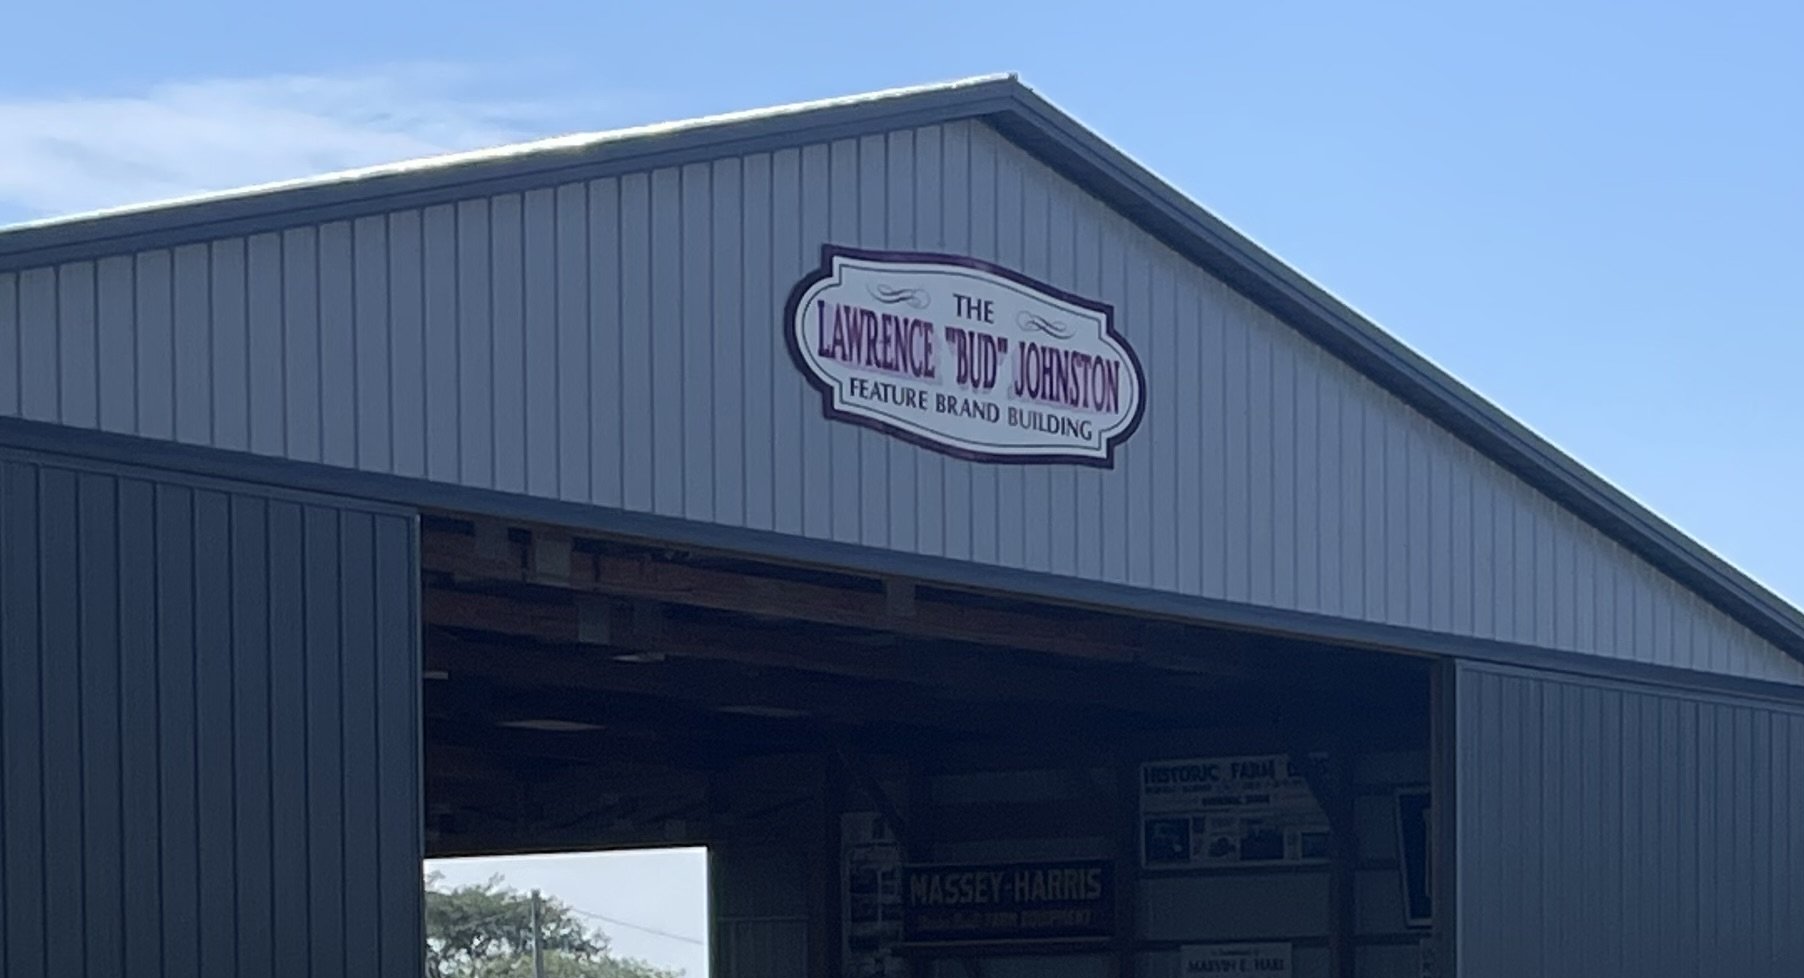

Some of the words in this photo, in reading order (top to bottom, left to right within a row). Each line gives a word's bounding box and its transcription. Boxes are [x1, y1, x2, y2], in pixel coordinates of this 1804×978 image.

[953, 293, 994, 324] THE
[817, 300, 936, 380] LAWRENCE
[945, 326, 1009, 391] "BUD"
[1013, 340, 1120, 415] JOHNSTON
[849, 377, 928, 410] FEATURE
[935, 395, 1001, 425] BRAND
[1007, 407, 1093, 442] BUILDING
[909, 868, 1102, 907] MASSEY-HARRIS
